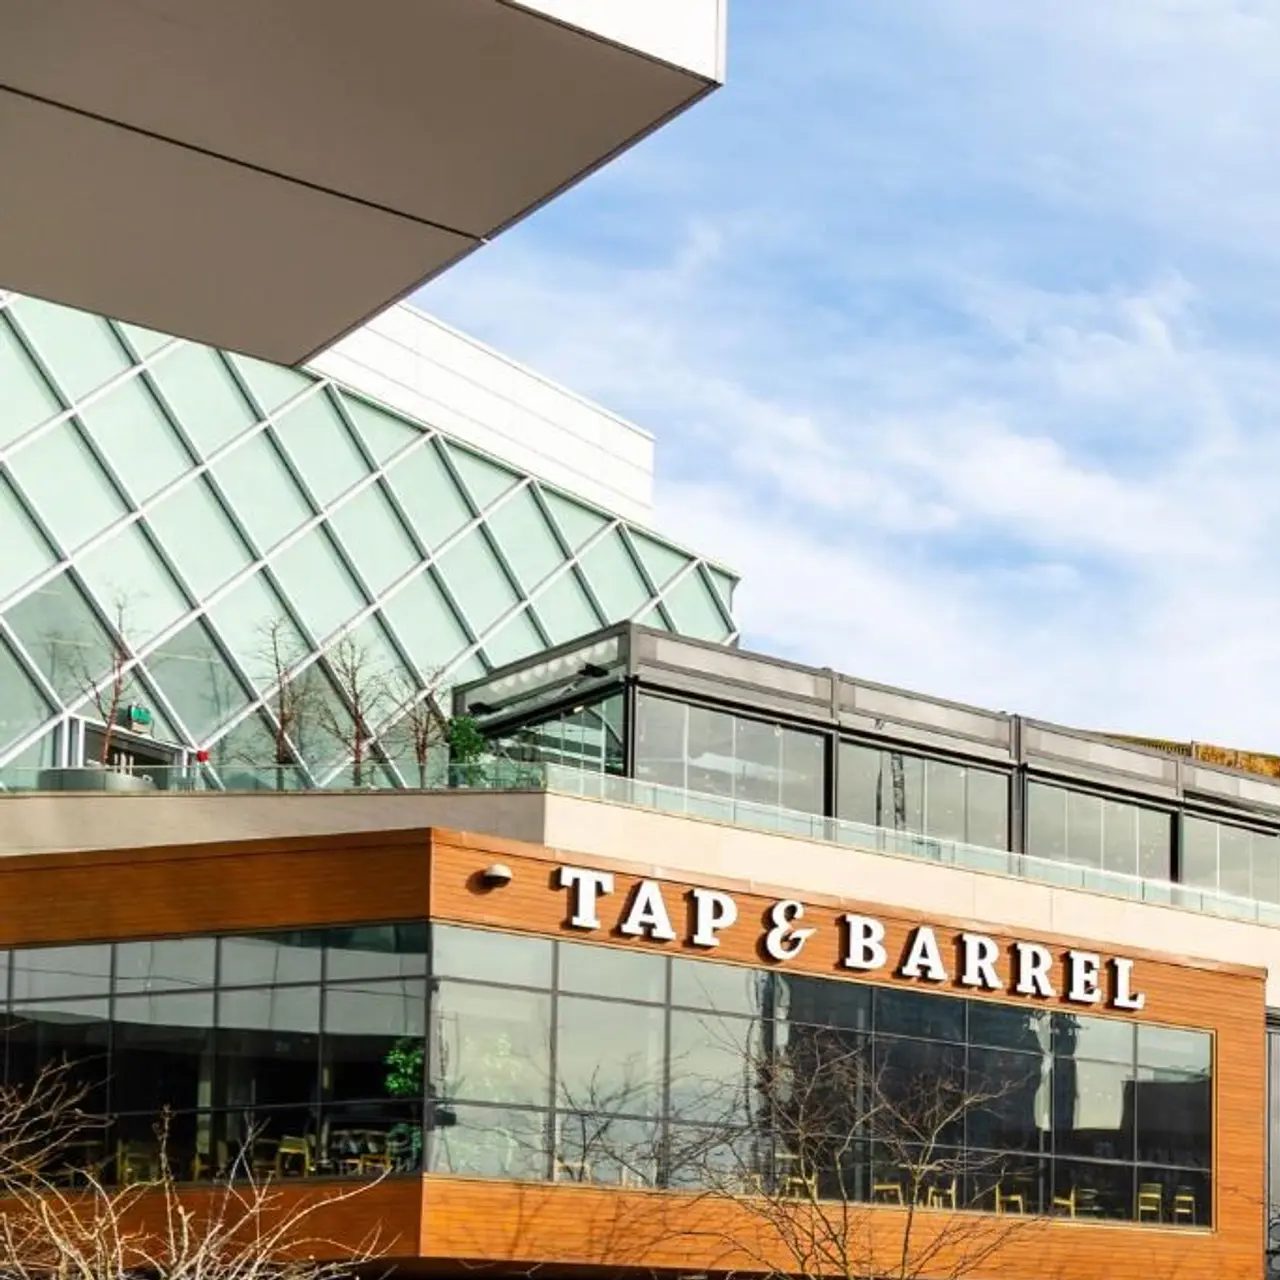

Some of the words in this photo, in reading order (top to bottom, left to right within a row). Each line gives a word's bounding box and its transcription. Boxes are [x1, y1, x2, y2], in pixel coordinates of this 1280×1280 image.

[559, 866, 739, 947] TAP
[766, 900, 817, 961] &
[845, 913, 1146, 1011] BARREL
